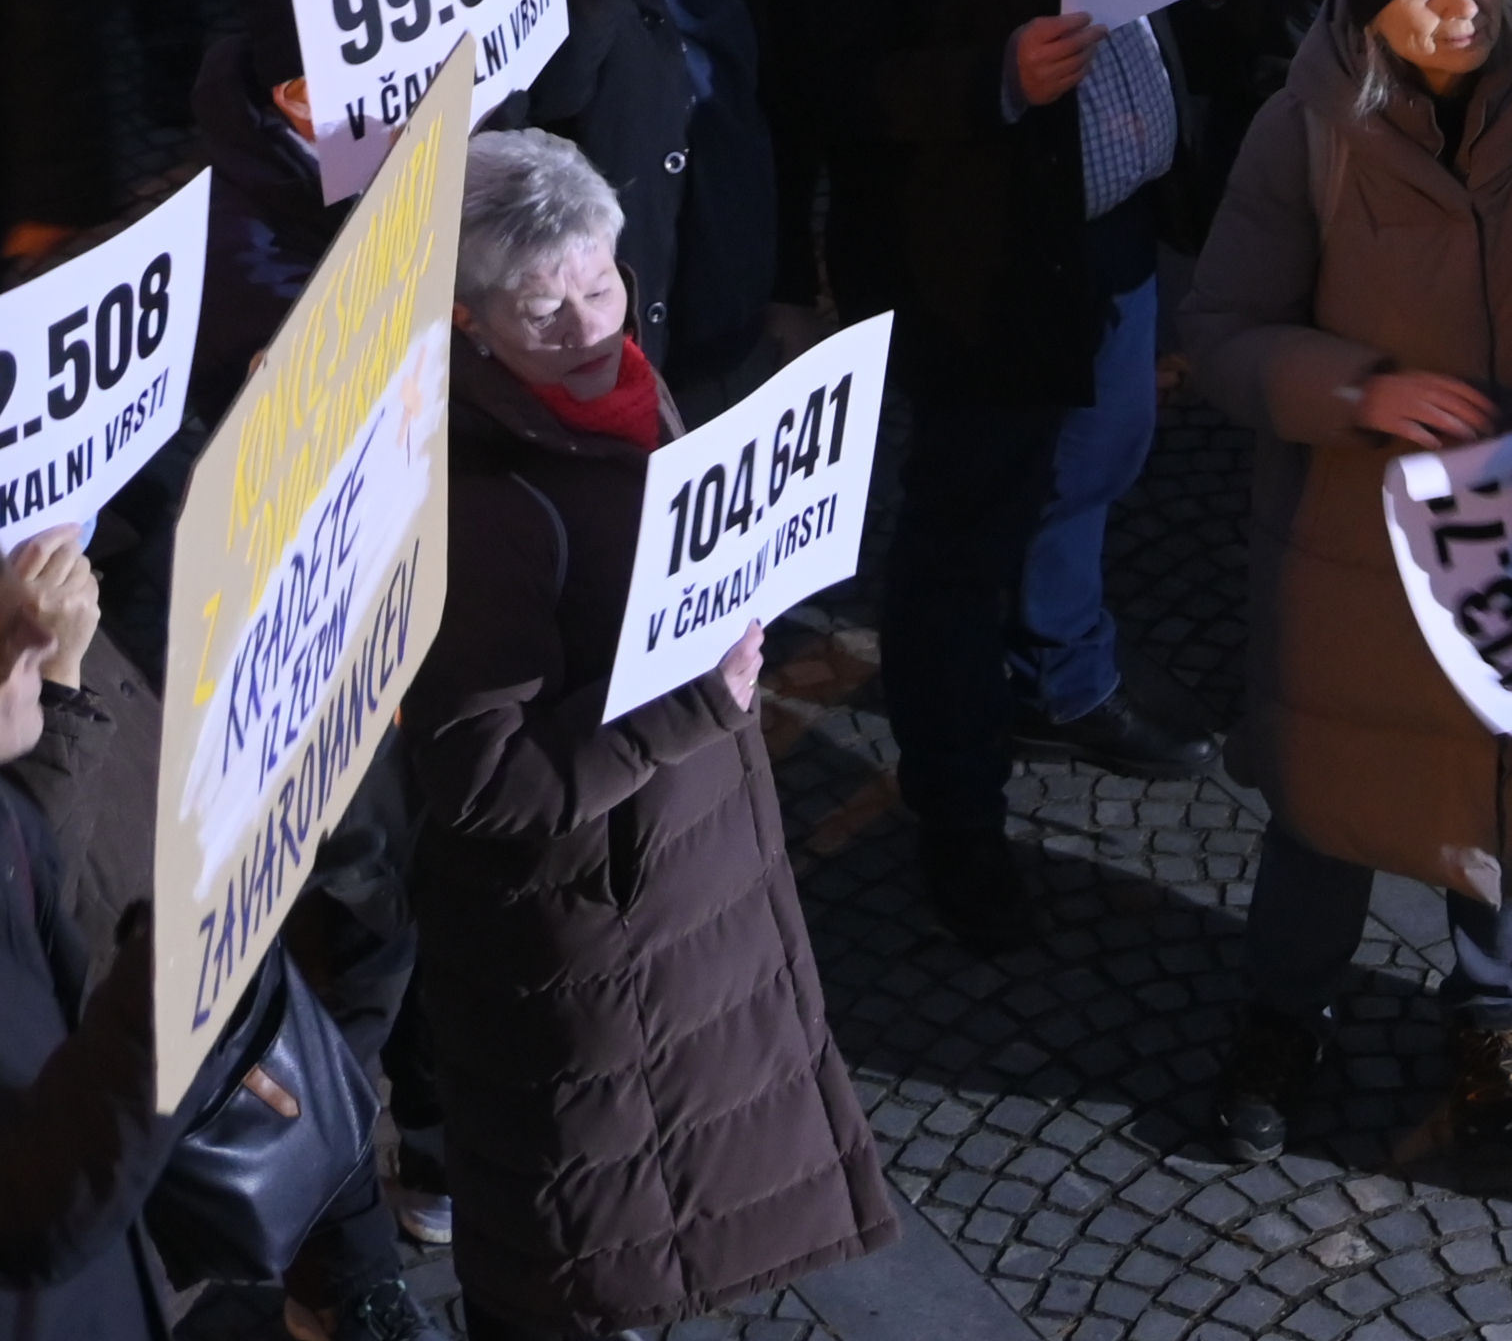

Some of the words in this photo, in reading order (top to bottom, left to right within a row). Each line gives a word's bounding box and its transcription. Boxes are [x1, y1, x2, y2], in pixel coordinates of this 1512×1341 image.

[345, 95, 366, 143] V
[104, 365, 170, 465] VRSTI
[666, 371, 854, 580] 104.641
[222, 405, 385, 778] KRADETE
[645, 607, 667, 654] V
[672, 536, 771, 641] ČAKALNI
[772, 491, 839, 570] VRSTI
[192, 590, 222, 708] Z
[191, 536, 421, 1033] ZAVAROVANCEV
[259, 703, 282, 794] IZ
